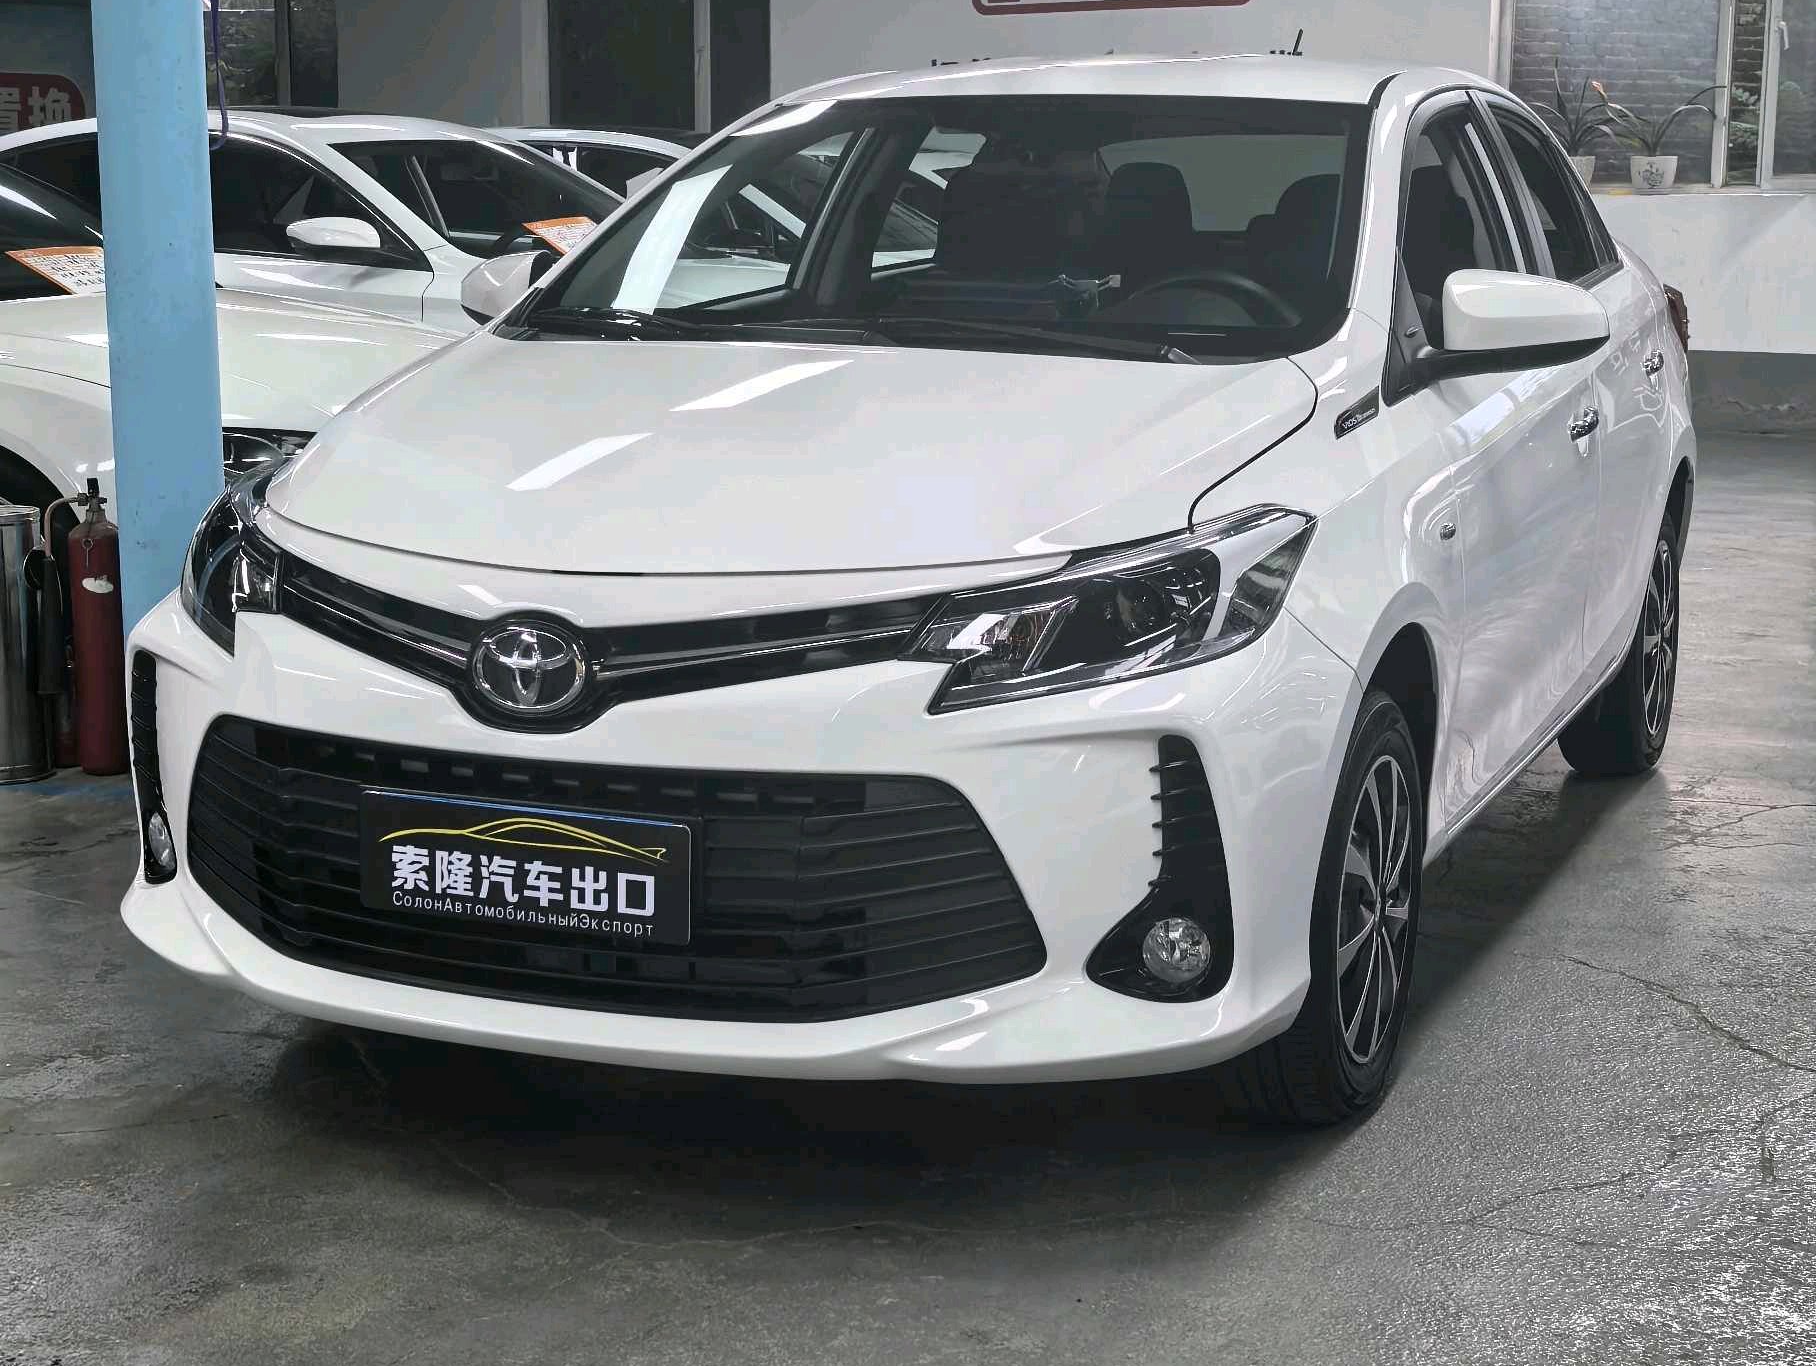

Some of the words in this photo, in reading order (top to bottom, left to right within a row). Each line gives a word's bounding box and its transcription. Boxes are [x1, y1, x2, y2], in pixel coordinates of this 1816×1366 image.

[391, 845, 655, 916] 索隆汽车出口
[392, 890, 653, 937] СолонАвтомобильныйЭкспорт
